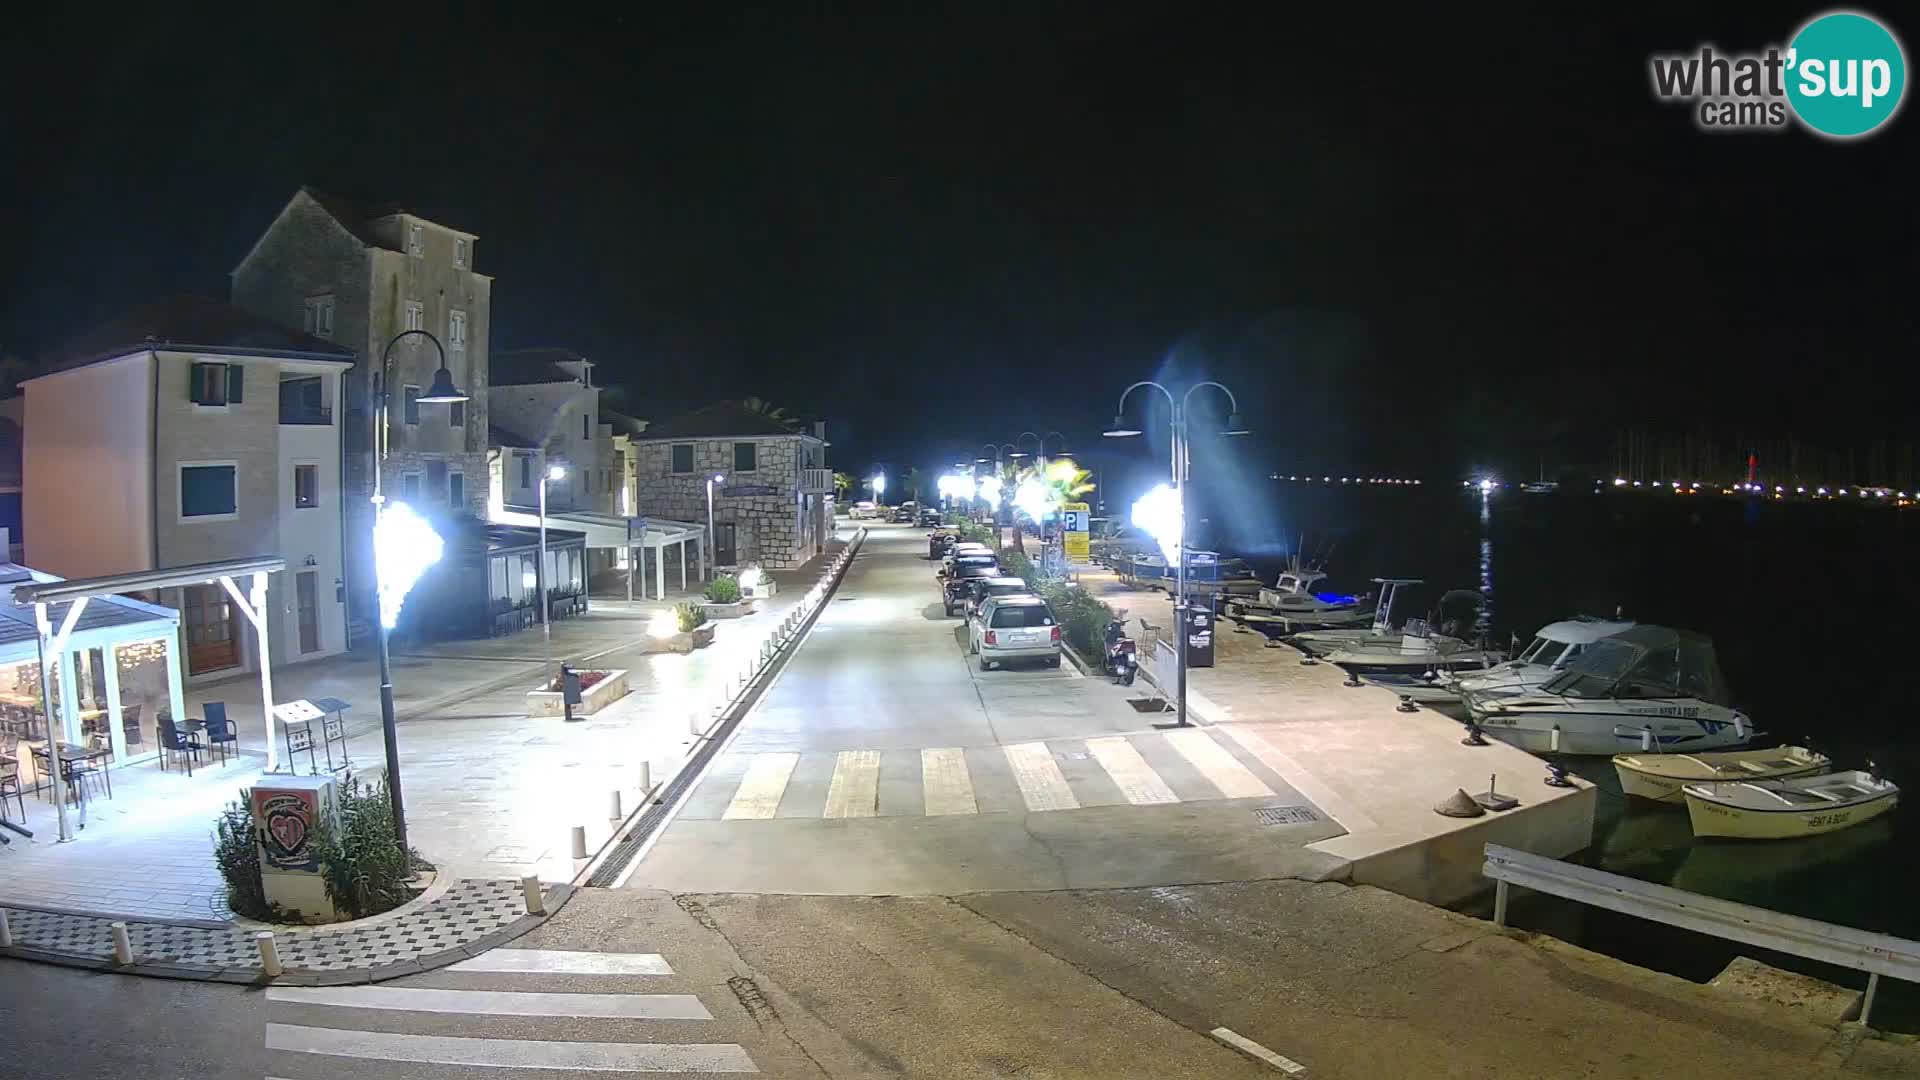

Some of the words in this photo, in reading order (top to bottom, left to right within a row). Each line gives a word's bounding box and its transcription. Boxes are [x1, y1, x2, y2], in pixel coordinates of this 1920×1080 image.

[1065, 513, 1076, 530] P
[1659, 706, 1675, 716] RENT
[1807, 815, 1826, 827] RENT
